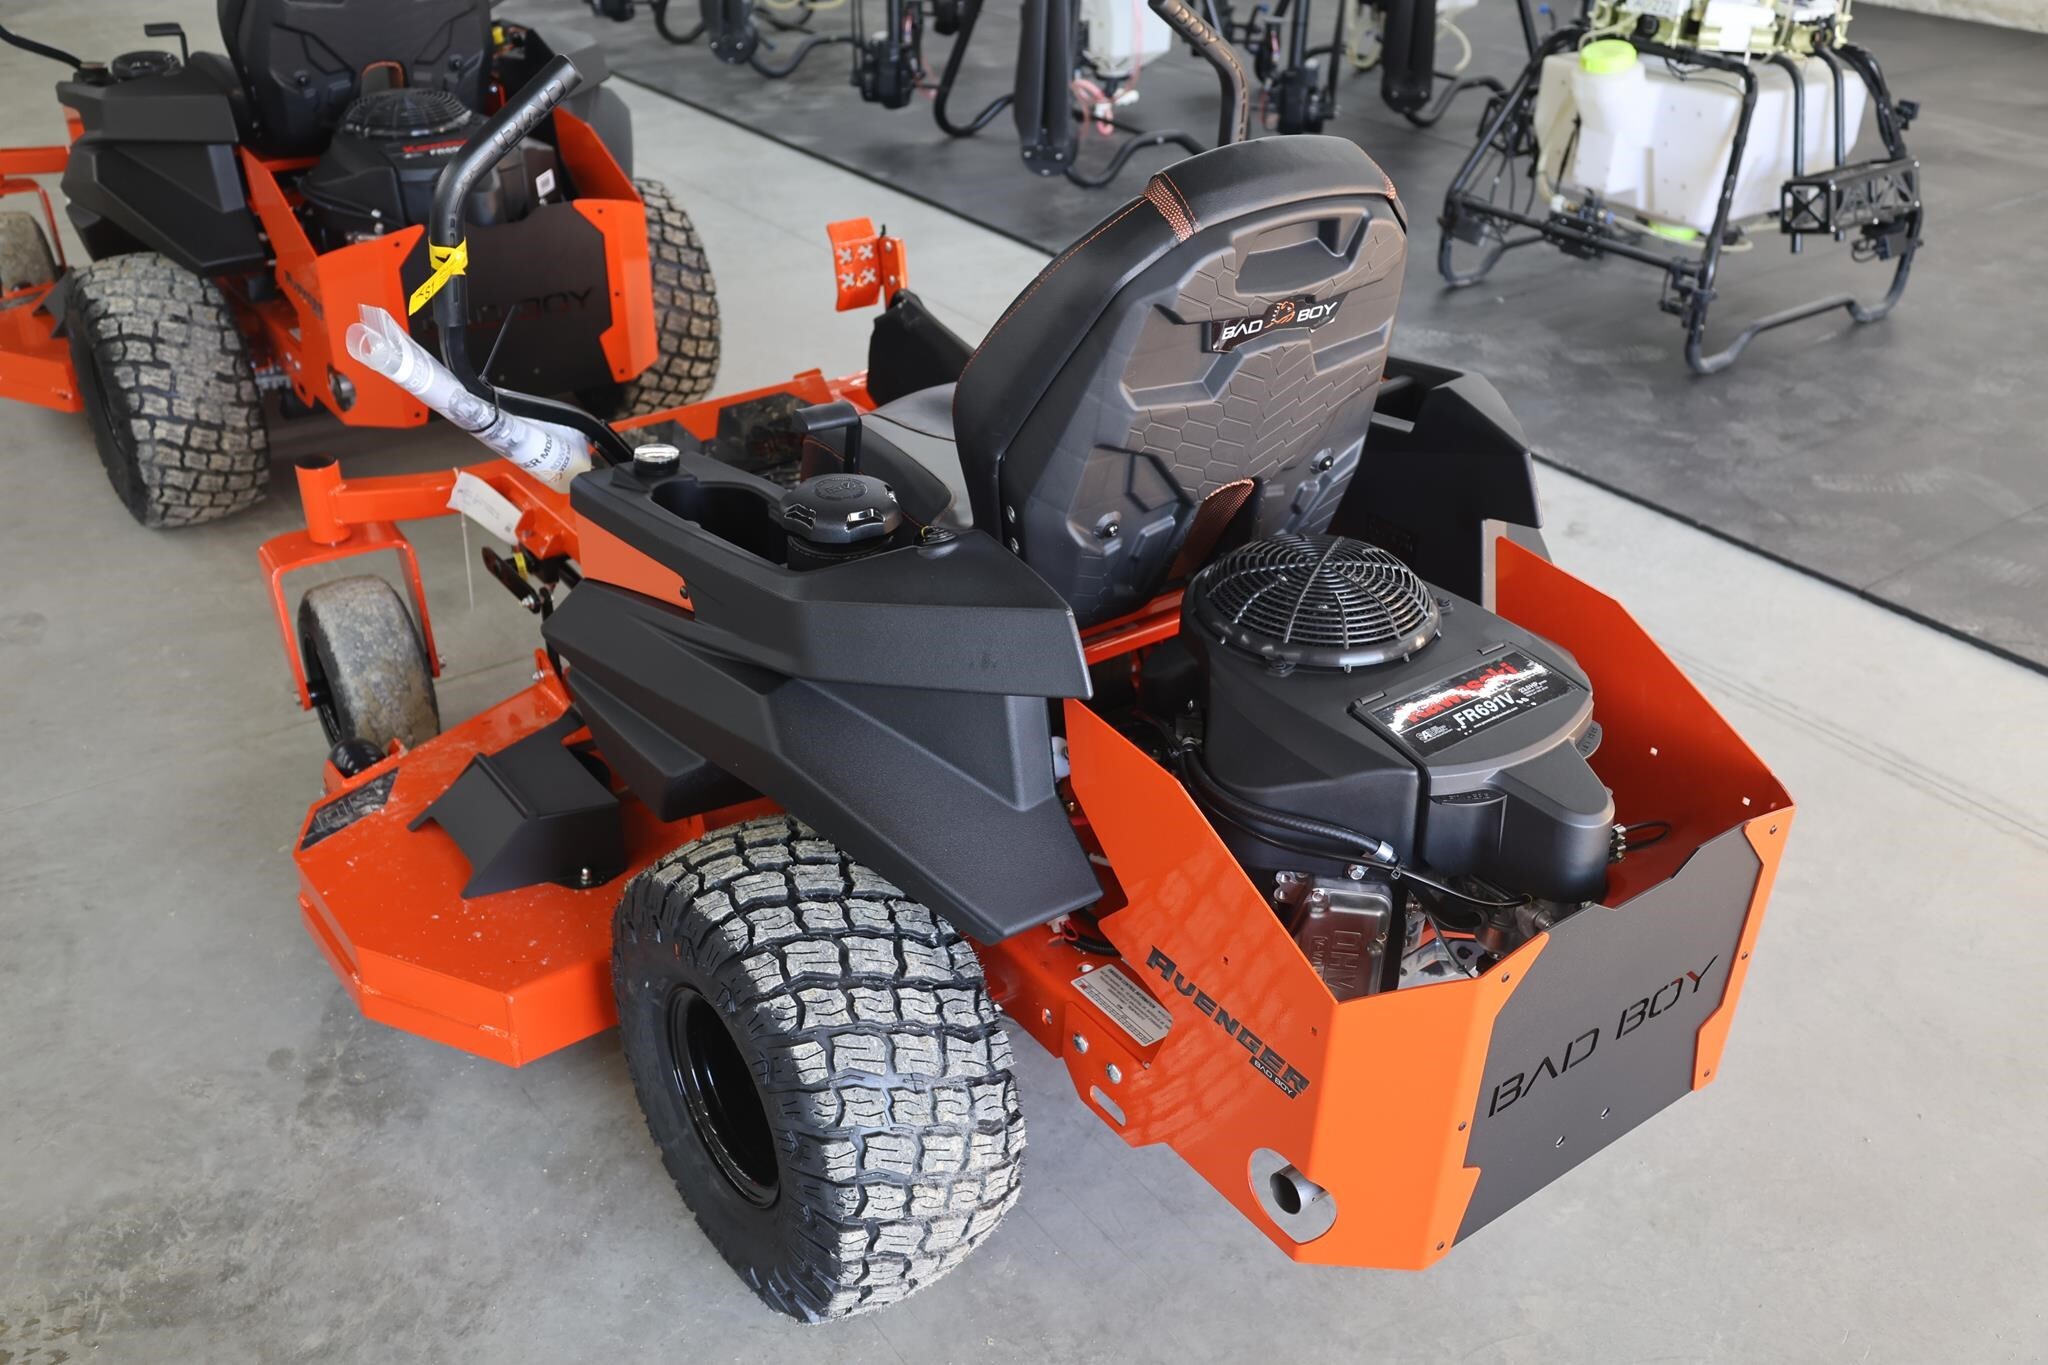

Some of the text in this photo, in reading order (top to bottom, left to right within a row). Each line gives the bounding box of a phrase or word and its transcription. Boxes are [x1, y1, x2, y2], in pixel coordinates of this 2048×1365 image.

[493, 79, 567, 154] BAD
[1222, 320, 1263, 340] BAD
[1297, 302, 1338, 322] BOY
[1452, 692, 1516, 727] FR691V
[1146, 945, 1311, 1094] AVENGER
[1488, 954, 1719, 1118] BAD BOY
[1253, 1059, 1294, 1095] BAD BOY
